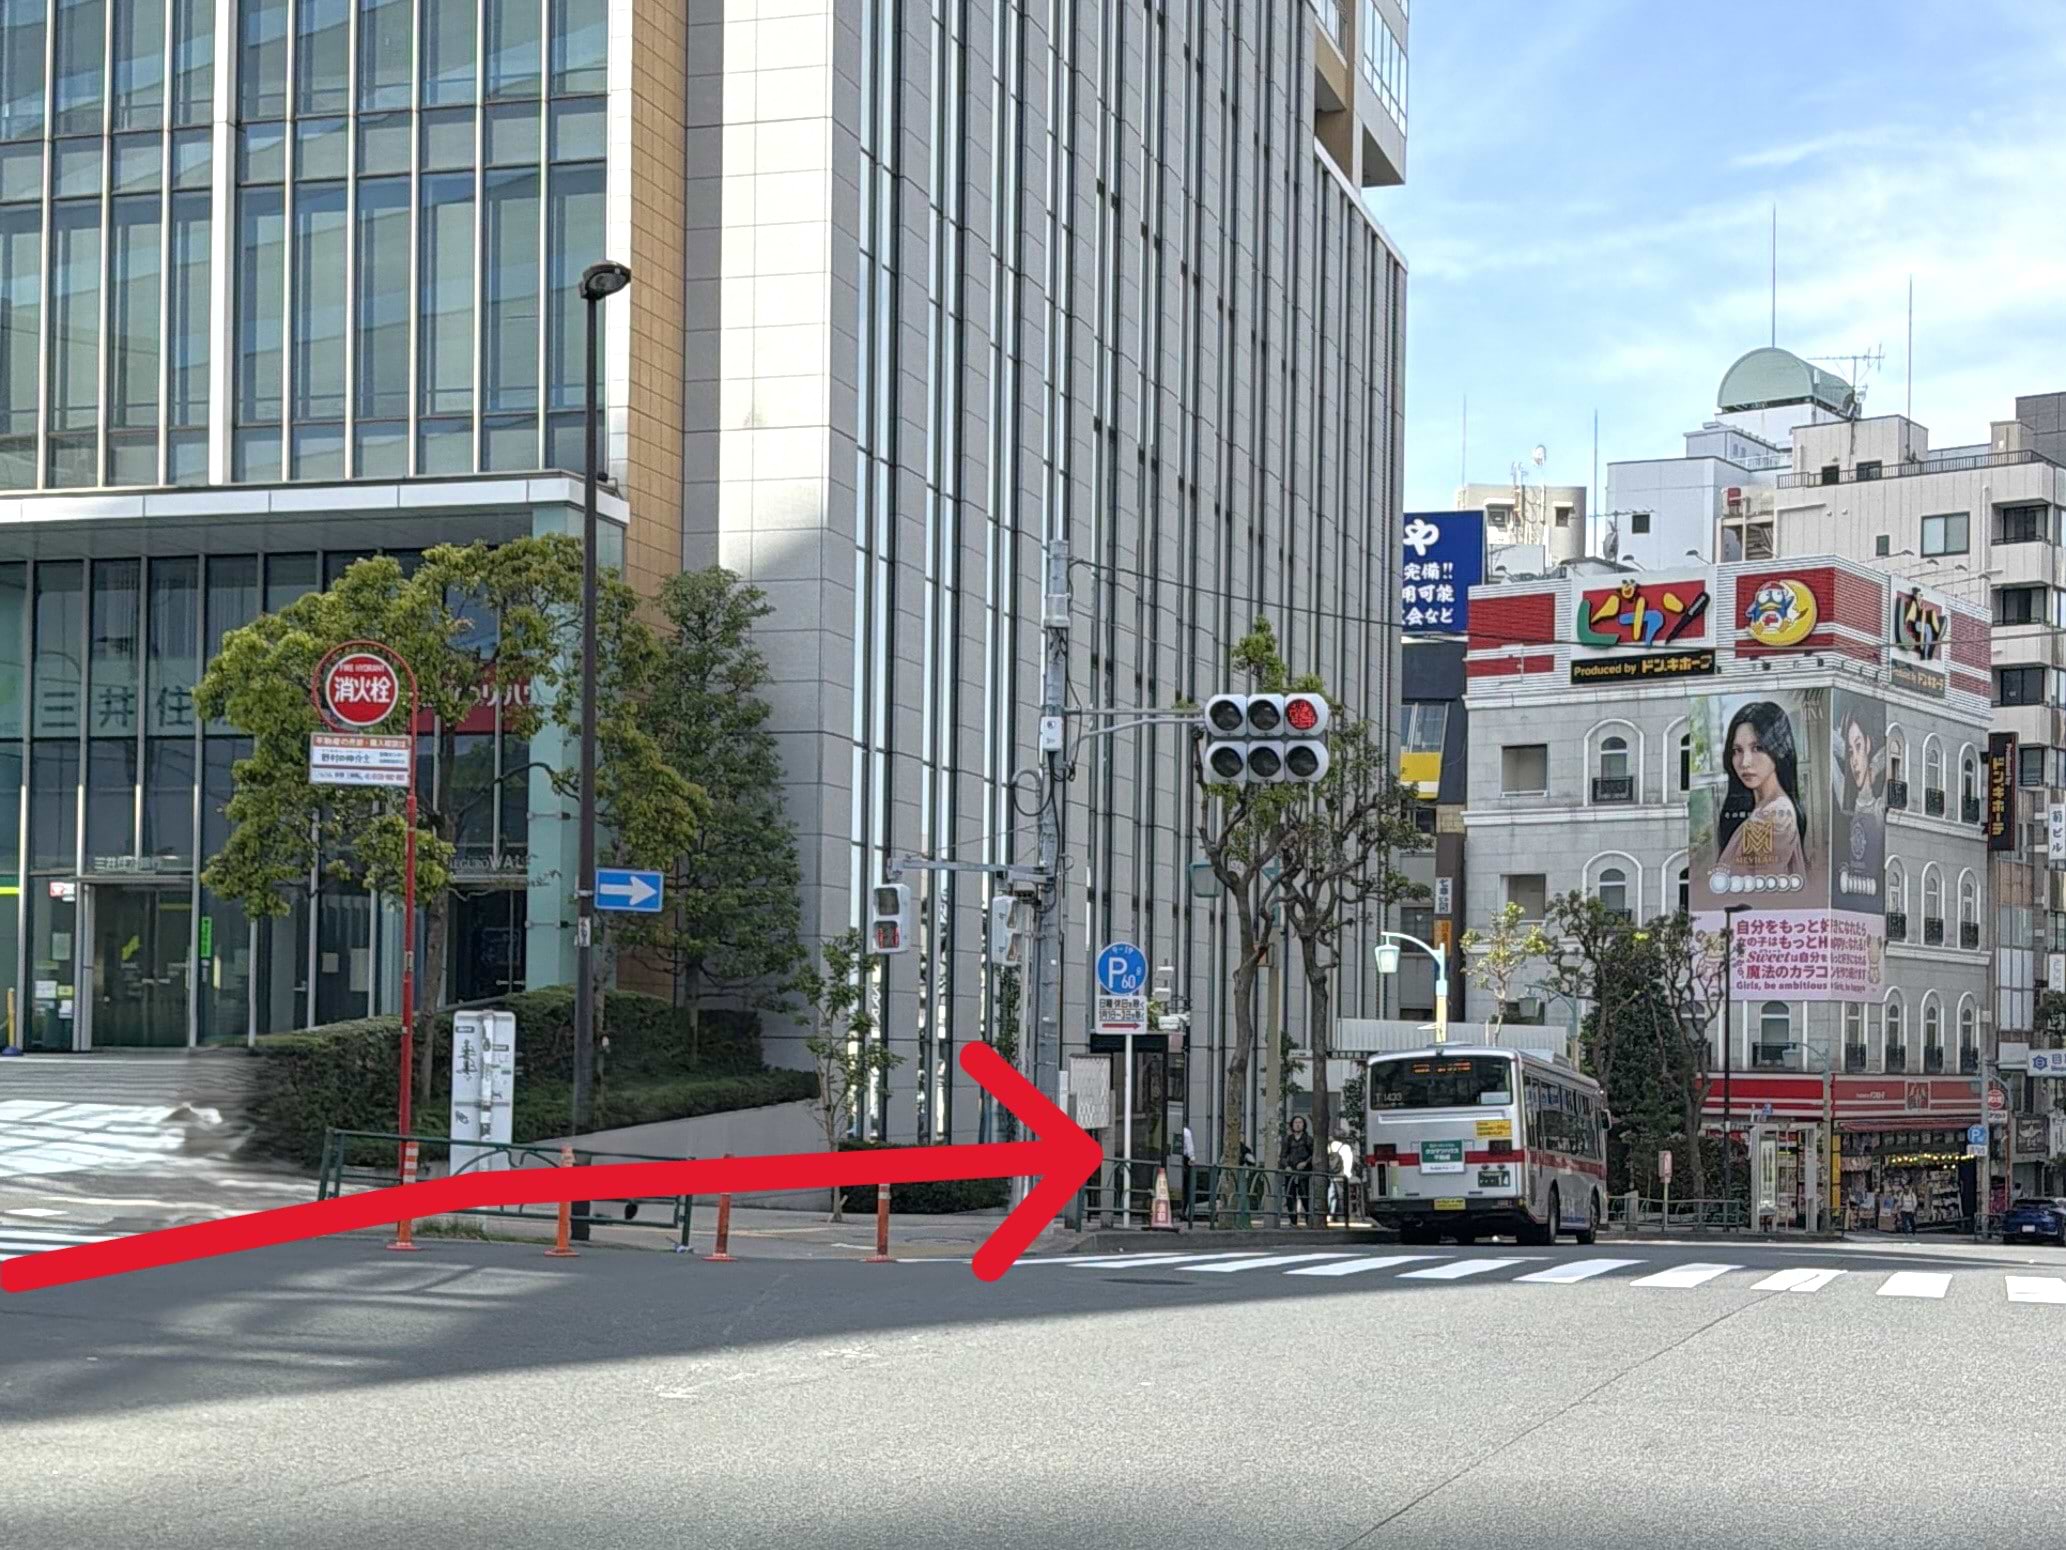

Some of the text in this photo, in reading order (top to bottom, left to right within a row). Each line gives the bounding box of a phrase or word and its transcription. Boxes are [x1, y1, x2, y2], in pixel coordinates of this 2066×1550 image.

[1573, 662, 1622, 677] Produced
[1623, 662, 1637, 675] by
[334, 676, 392, 703] 消火栓
[41, 685, 228, 728] 三井住
[1108, 957, 1128, 989] P
[1736, 981, 1828, 991] Girls, be ambitious
